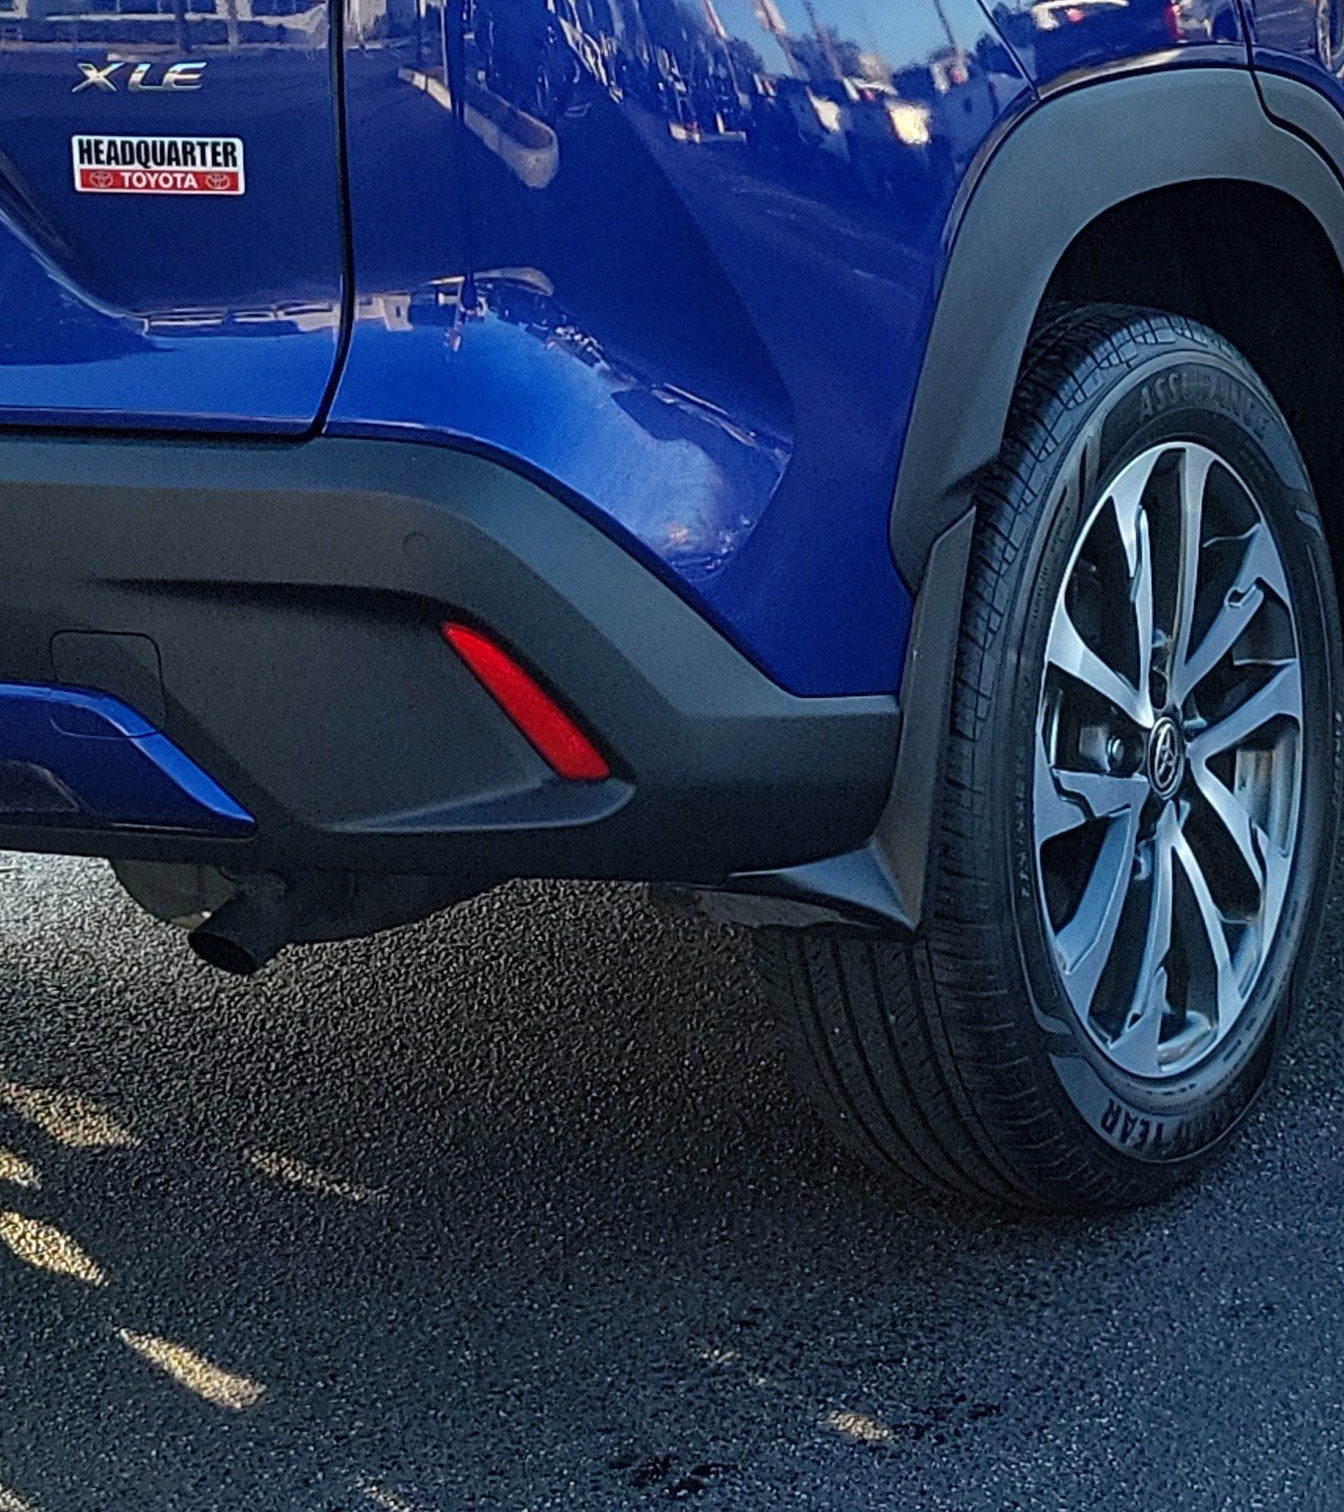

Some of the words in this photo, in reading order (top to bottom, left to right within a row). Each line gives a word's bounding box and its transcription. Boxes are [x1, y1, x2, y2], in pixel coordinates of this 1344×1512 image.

[71, 61, 209, 93] XLE
[77, 138, 239, 170] HEADQUARTER
[119, 171, 199, 190] TOYOTA
